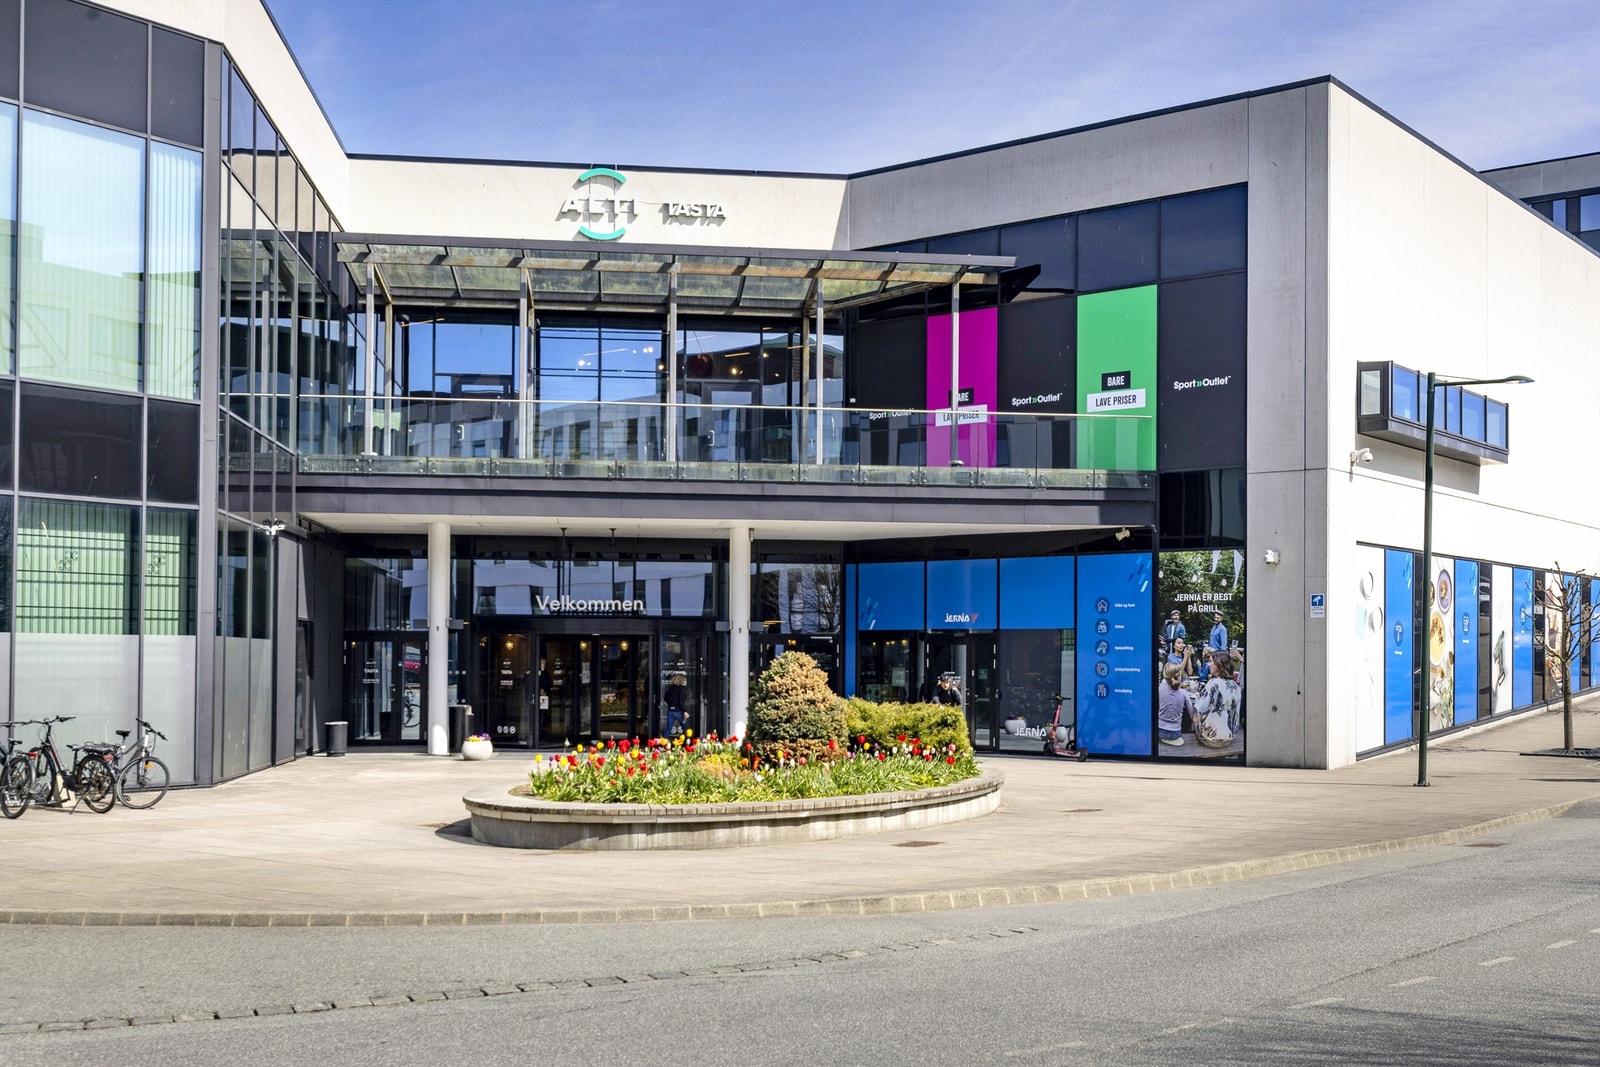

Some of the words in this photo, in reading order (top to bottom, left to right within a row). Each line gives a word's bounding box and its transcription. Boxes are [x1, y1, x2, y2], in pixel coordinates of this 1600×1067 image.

[561, 194, 640, 215] ALTI
[666, 200, 726, 218] TASTA
[1107, 375, 1125, 387] BARE
[1095, 396, 1112, 407] LAVE
[1112, 394, 1137, 406] PRISER
[535, 595, 644, 611] Velkommen
[1174, 593, 1201, 602] JERNIA
[1202, 593, 1212, 601] ER
[1213, 592, 1233, 601] BEST
[1187, 602, 1198, 613] PÅ
[1198, 604, 1219, 613] GRILL
